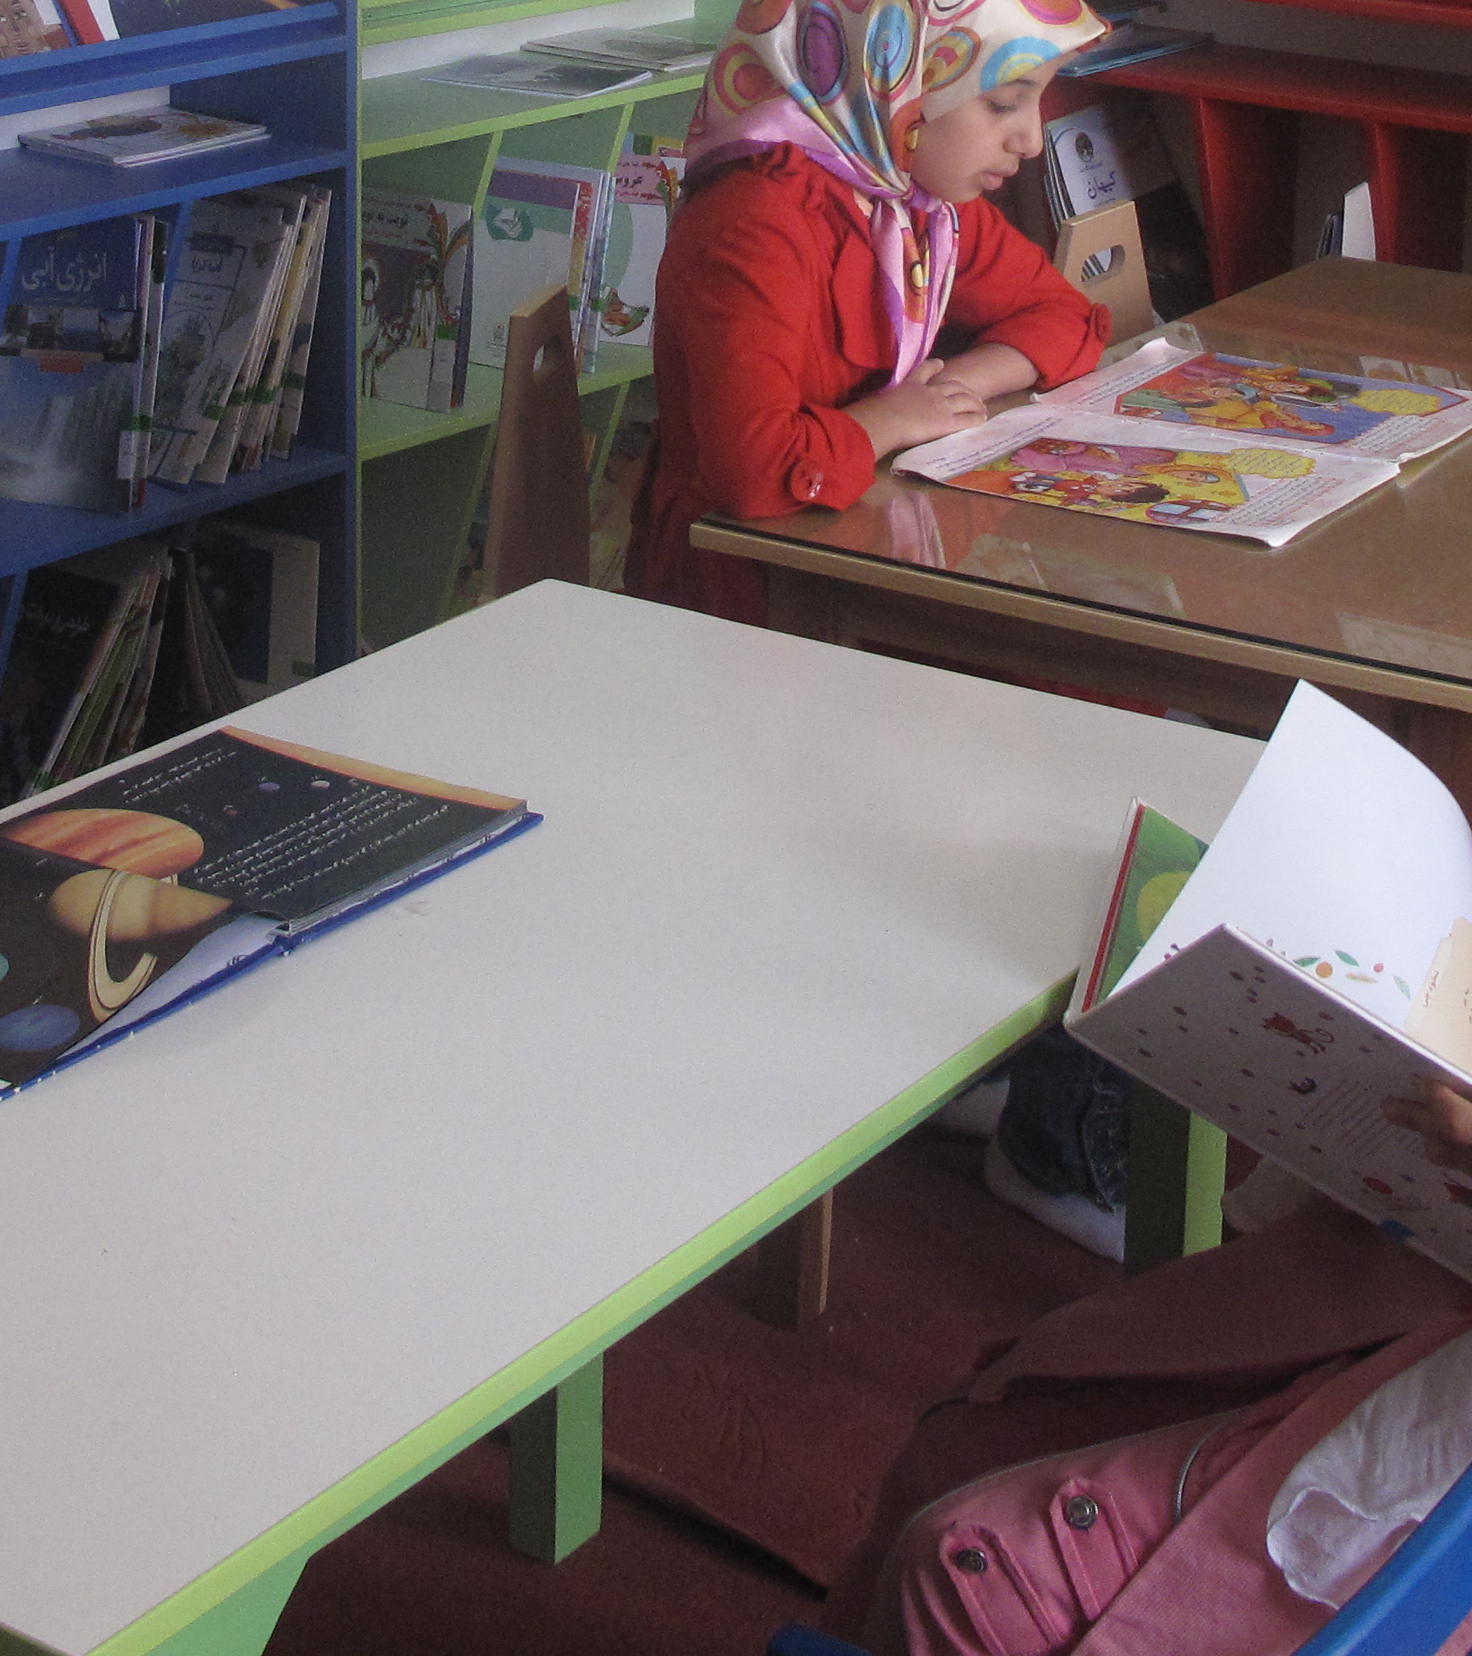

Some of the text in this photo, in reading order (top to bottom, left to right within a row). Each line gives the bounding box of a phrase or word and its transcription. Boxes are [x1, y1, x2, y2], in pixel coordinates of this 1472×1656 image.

[1087, 170, 1116, 200] کیهان
[21, 245, 108, 292] انرژی آبی
